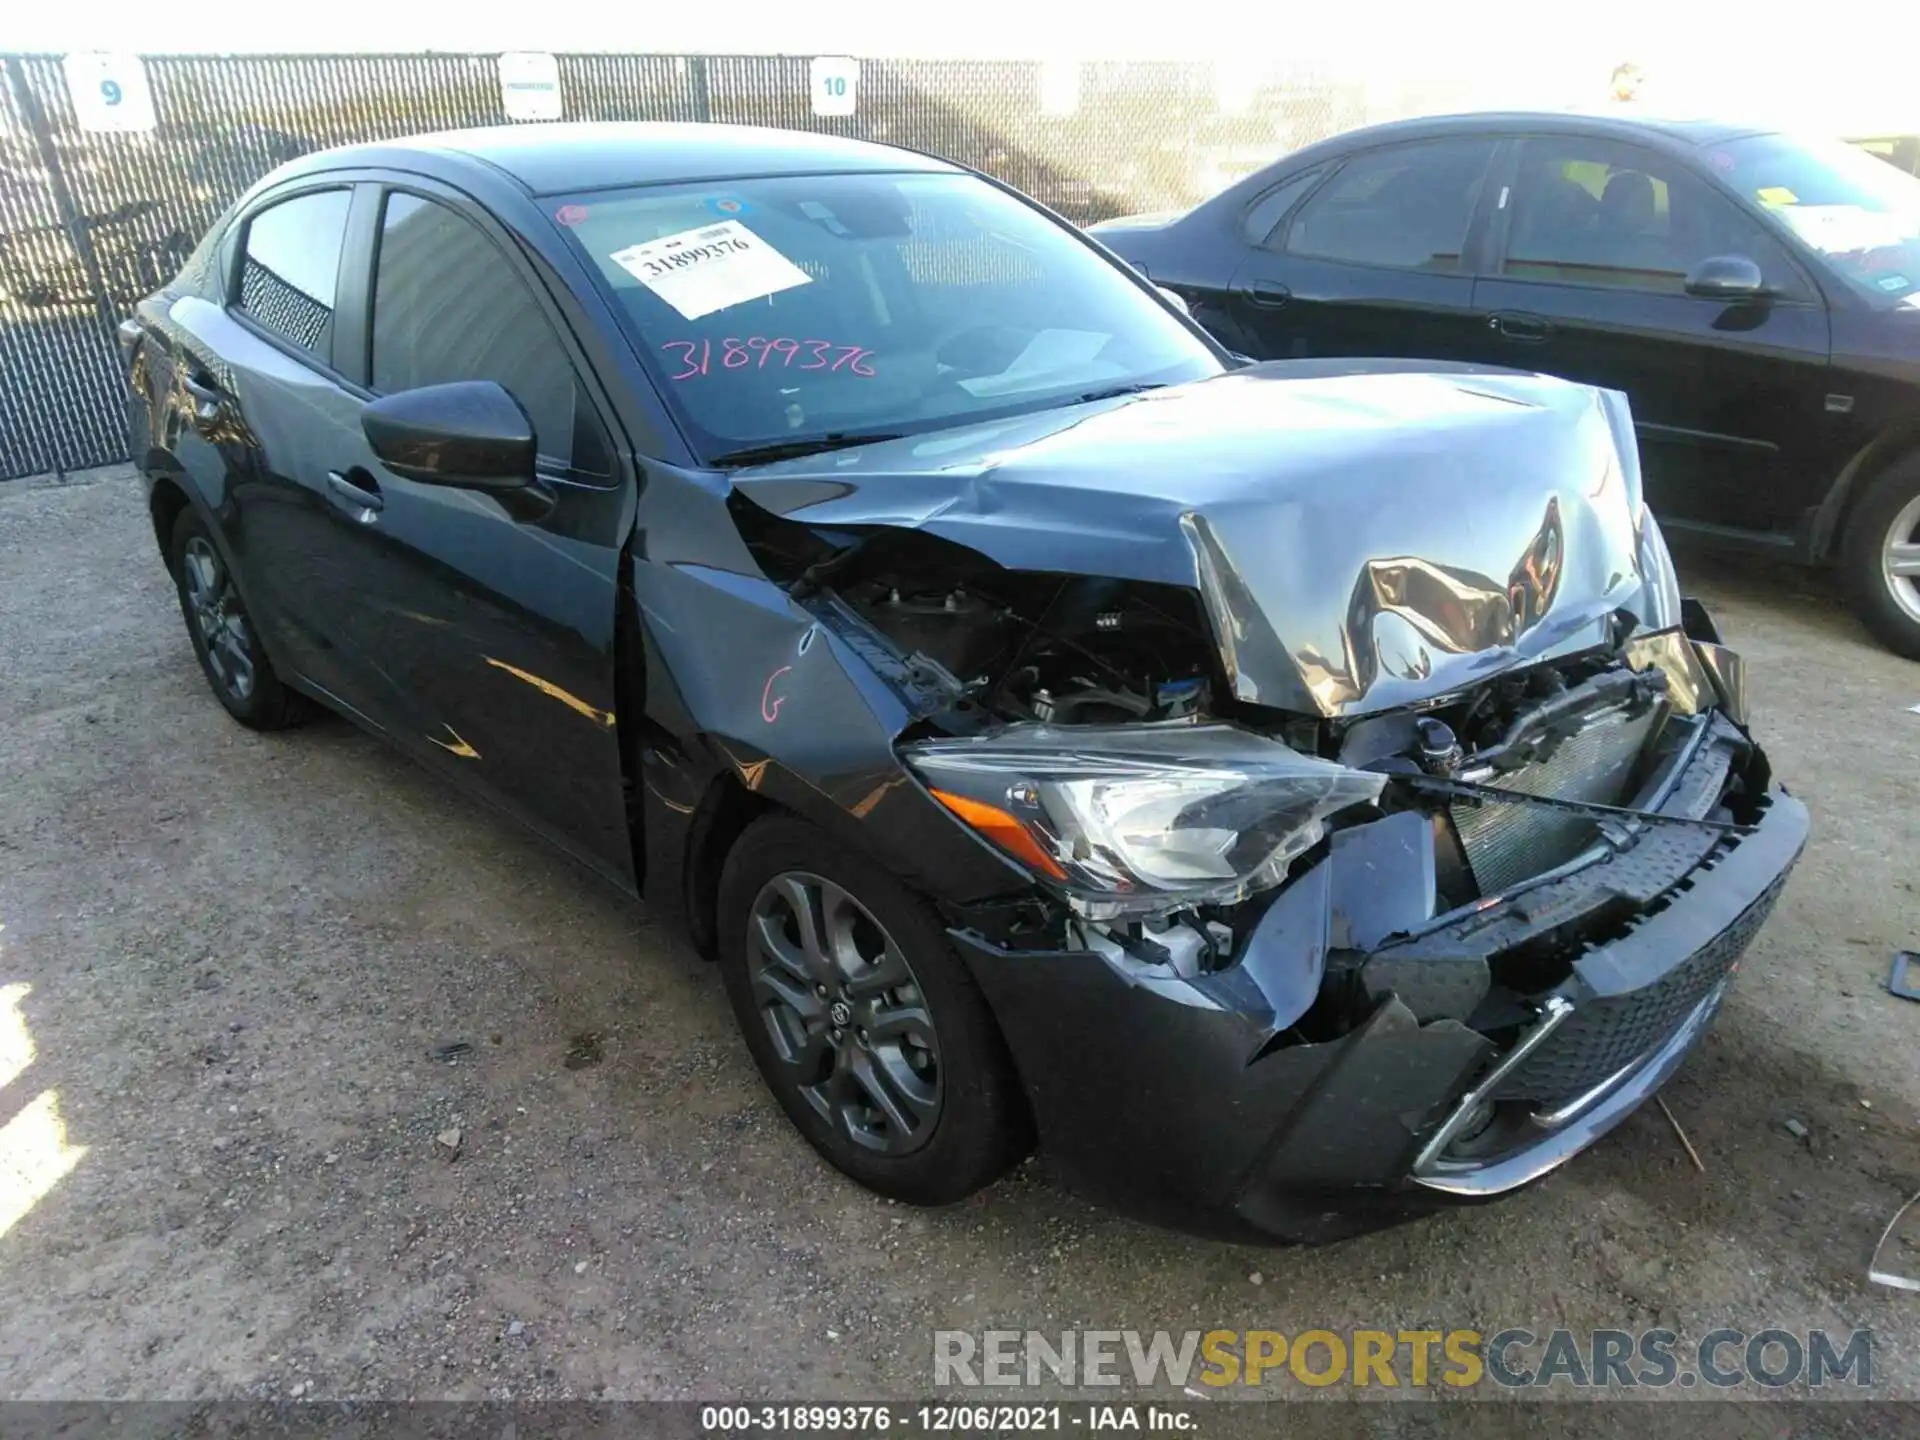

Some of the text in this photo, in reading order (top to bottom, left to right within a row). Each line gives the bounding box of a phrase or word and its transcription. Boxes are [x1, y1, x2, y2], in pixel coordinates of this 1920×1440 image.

[101, 80, 122, 106] 9
[824, 77, 846, 96] 10
[642, 237, 750, 276] 31899376
[661, 336, 878, 381] 31899376
